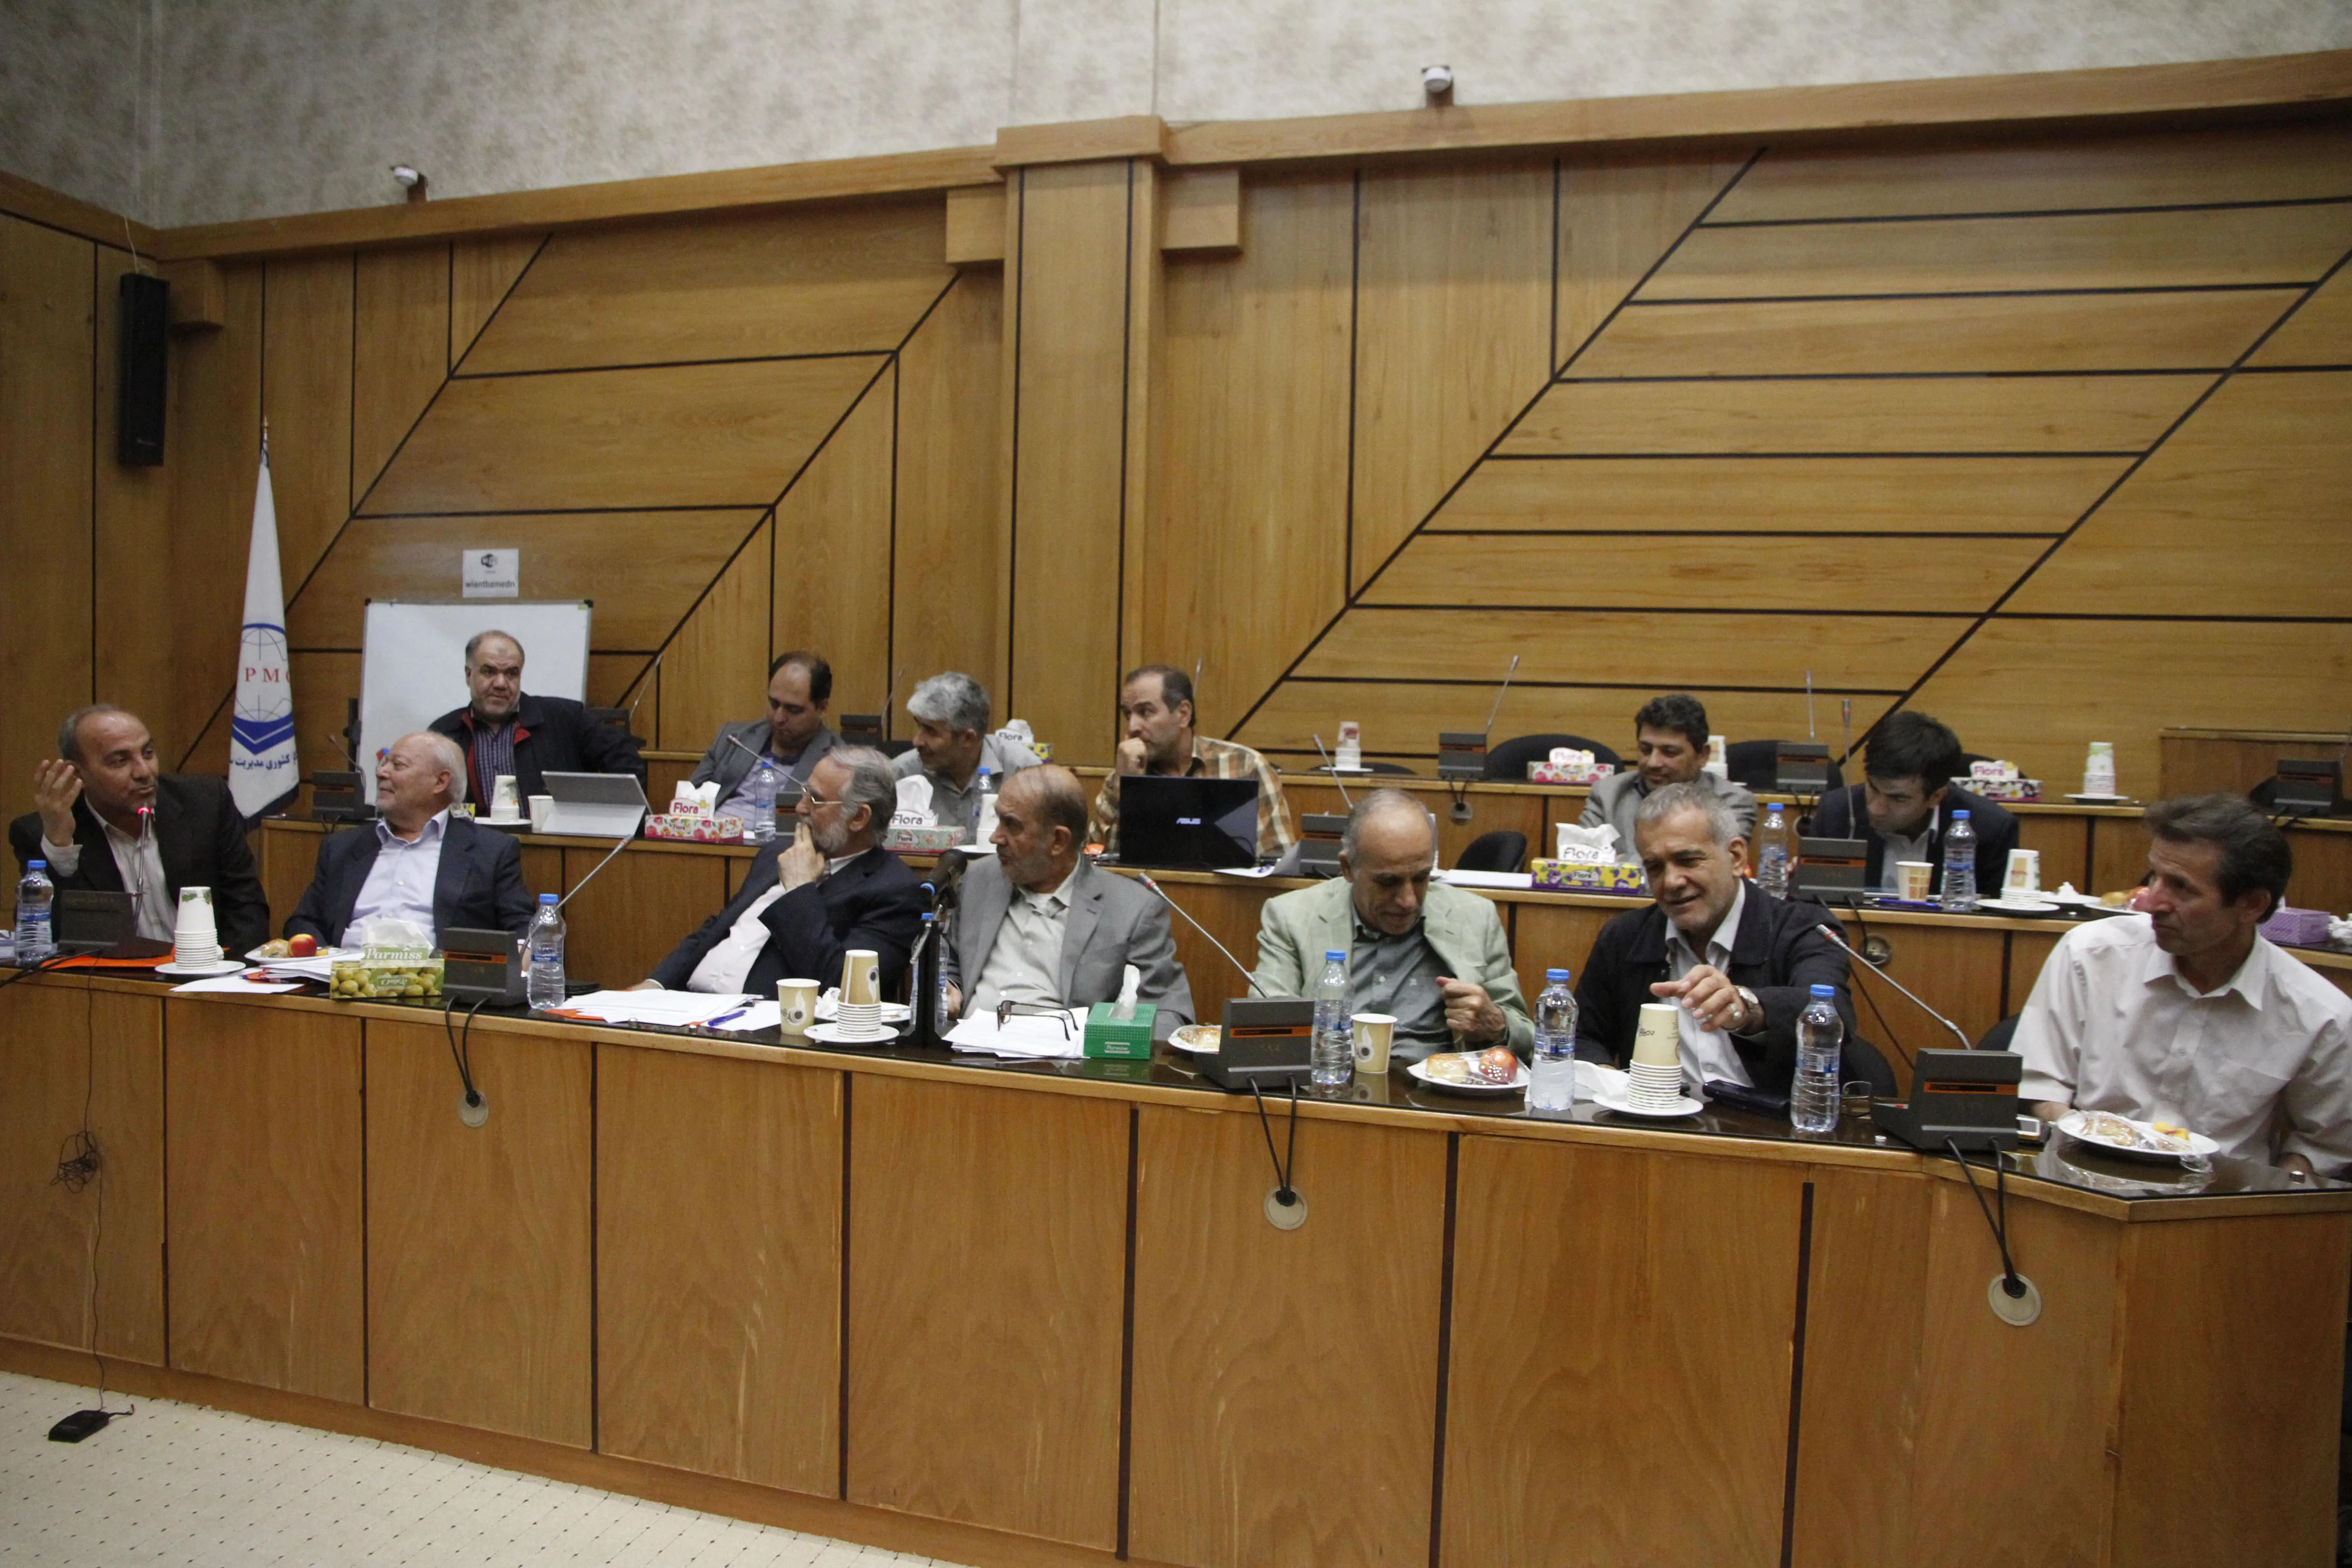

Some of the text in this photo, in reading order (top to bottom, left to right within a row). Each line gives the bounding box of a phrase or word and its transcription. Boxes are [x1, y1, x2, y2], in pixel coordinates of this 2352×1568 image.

[673, 802, 699, 813] Flora
[892, 814, 923, 825] Flora
[1564, 848, 1599, 859] Flora
[366, 946, 423, 960] Parmiss
